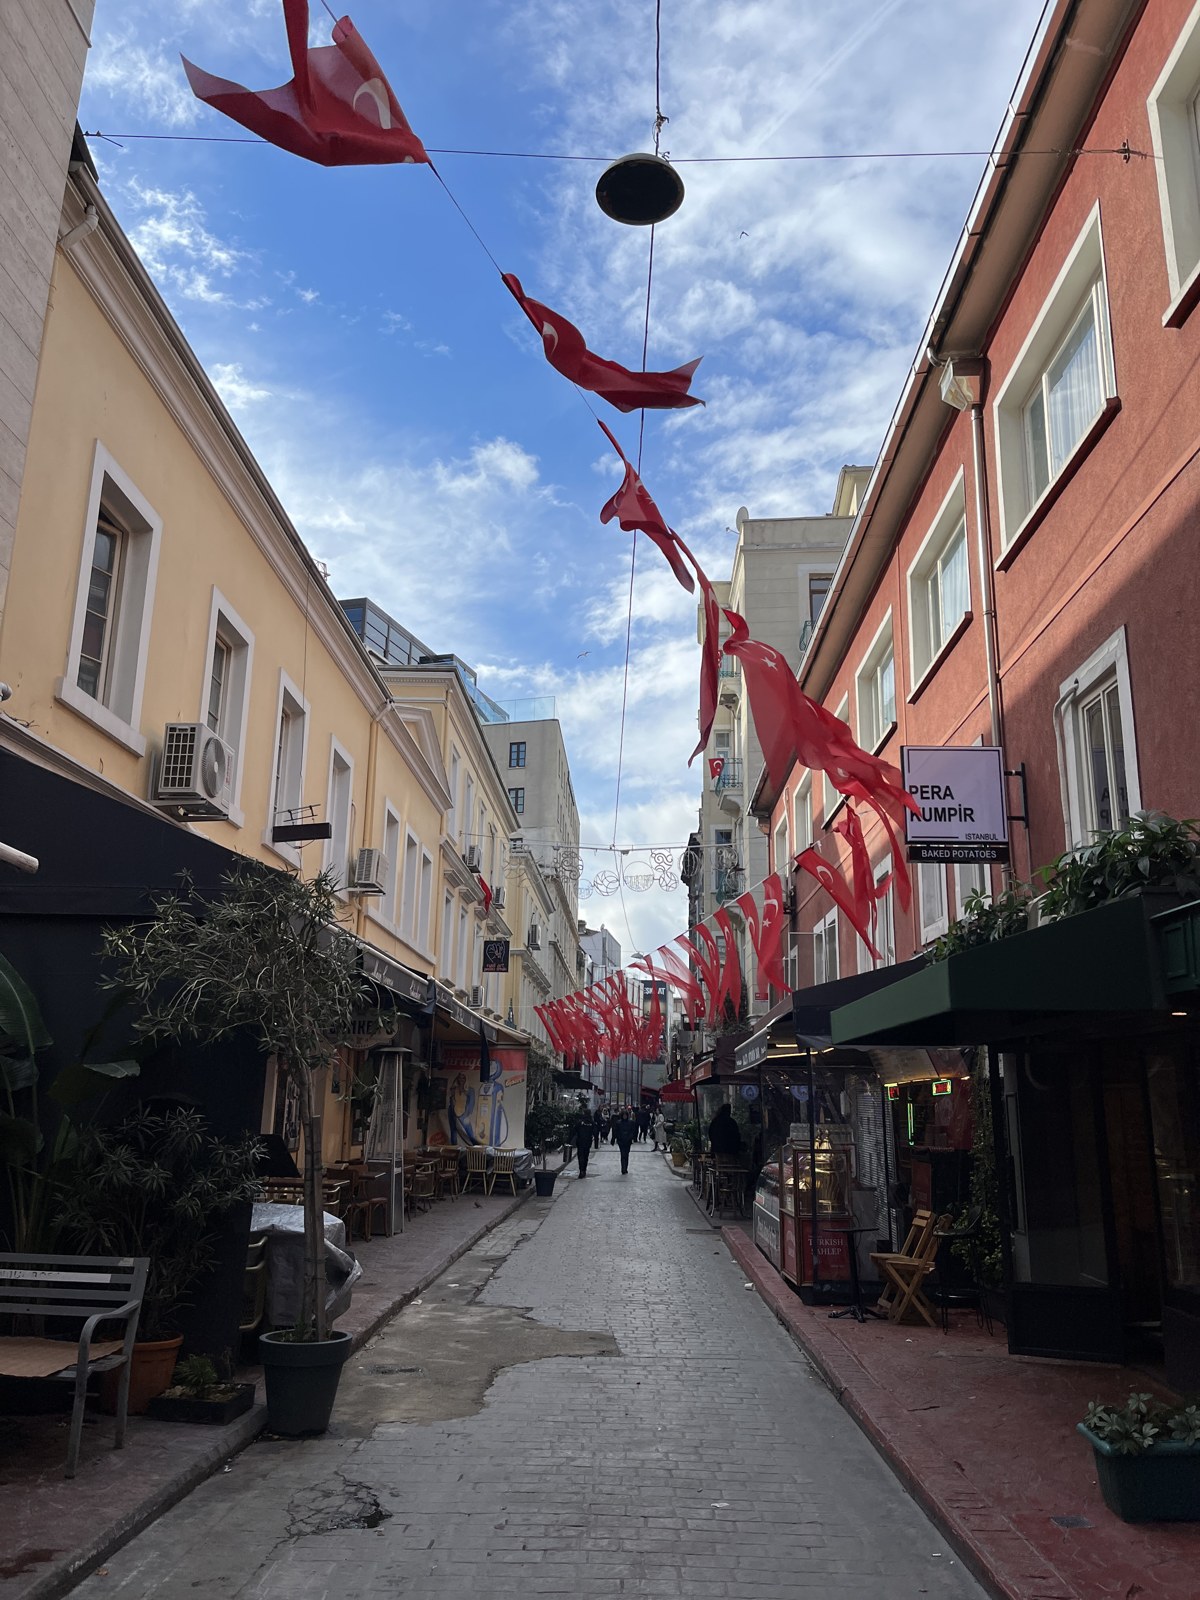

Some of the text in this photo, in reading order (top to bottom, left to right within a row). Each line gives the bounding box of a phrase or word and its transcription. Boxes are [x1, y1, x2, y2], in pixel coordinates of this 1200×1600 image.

[908, 785, 954, 800] PERA
[910, 804, 975, 822] KUMPİR
[921, 850, 996, 858] BAKED POTATOES
